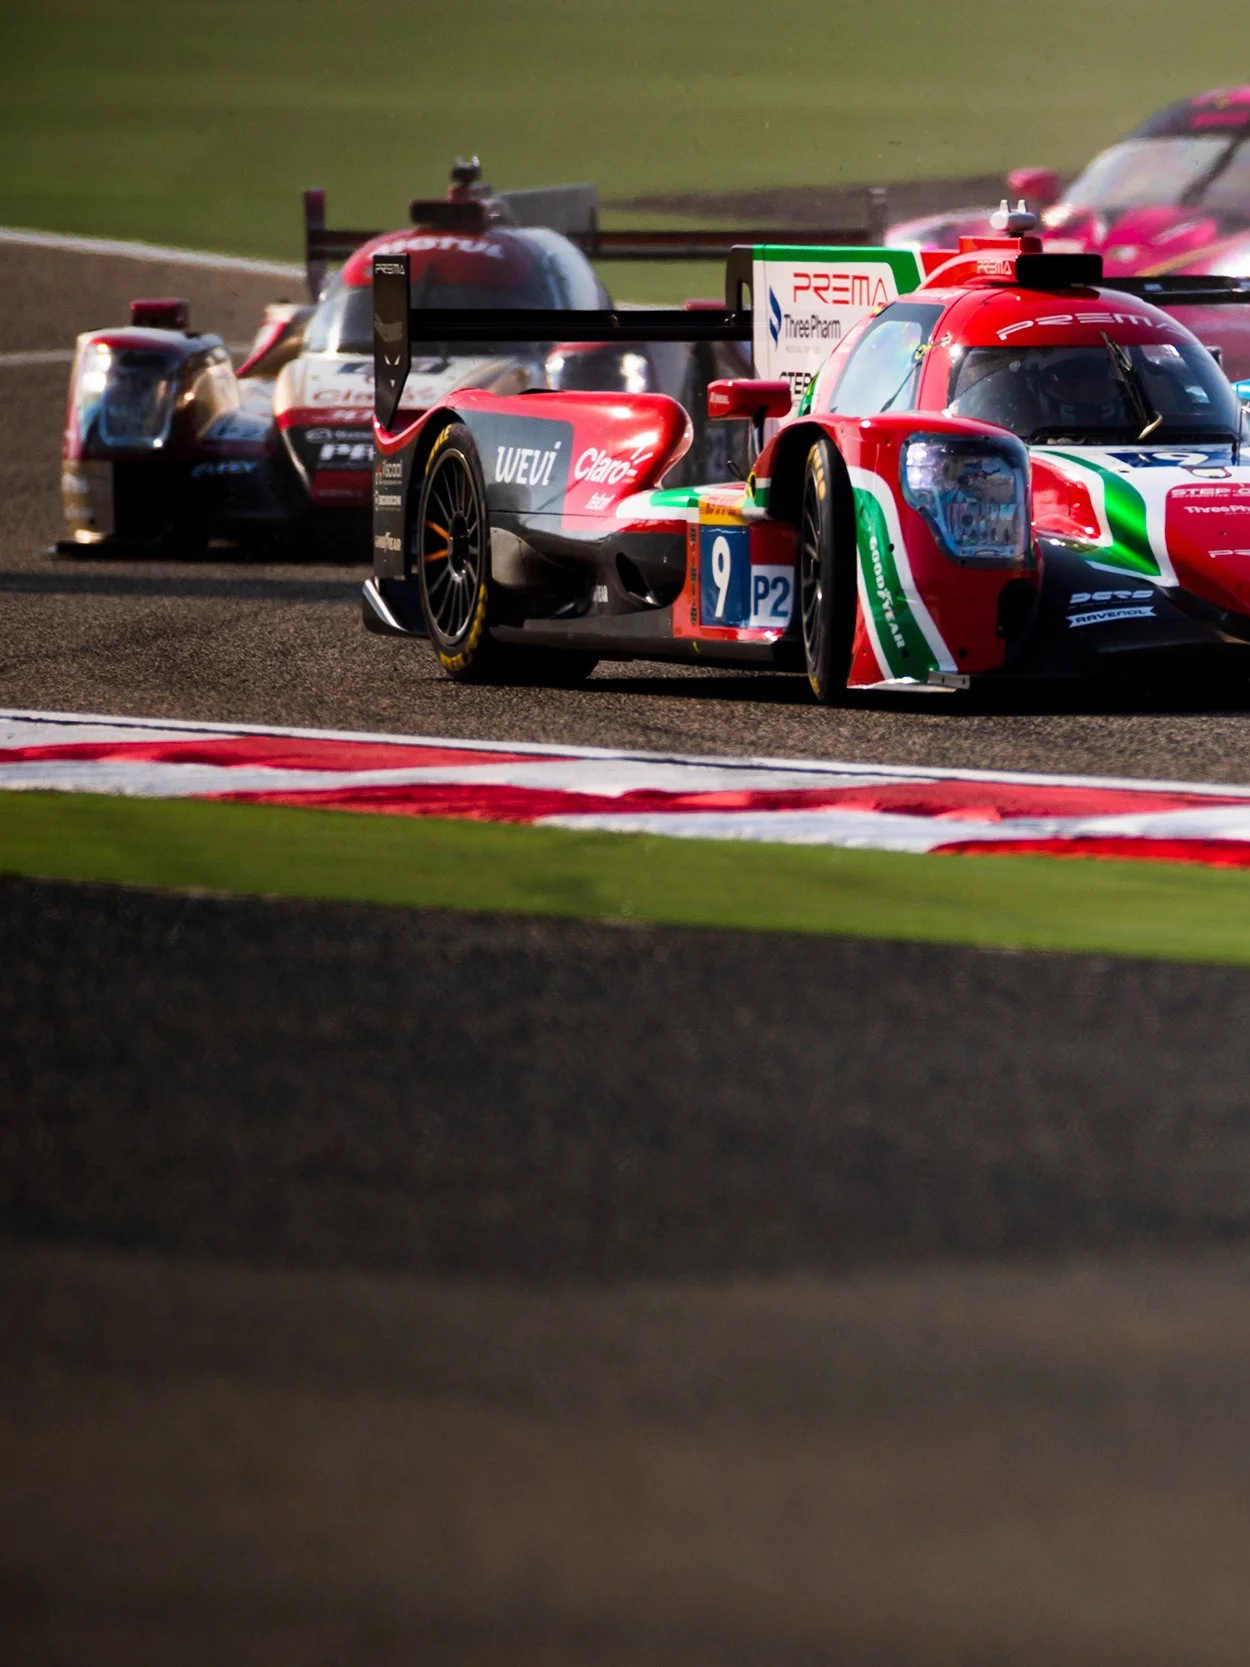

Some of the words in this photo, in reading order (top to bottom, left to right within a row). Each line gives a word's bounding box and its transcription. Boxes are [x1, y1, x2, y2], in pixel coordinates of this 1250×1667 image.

[976, 260, 1012, 274] PREMA
[793, 273, 889, 306] PREMA
[996, 312, 1191, 341] PREMA
[574, 447, 628, 485] Claro
[712, 535, 731, 618] 9
[869, 535, 906, 649] GOODYEAR
[753, 575, 790, 618] P2
[1075, 609, 1148, 624] RAVENOL
